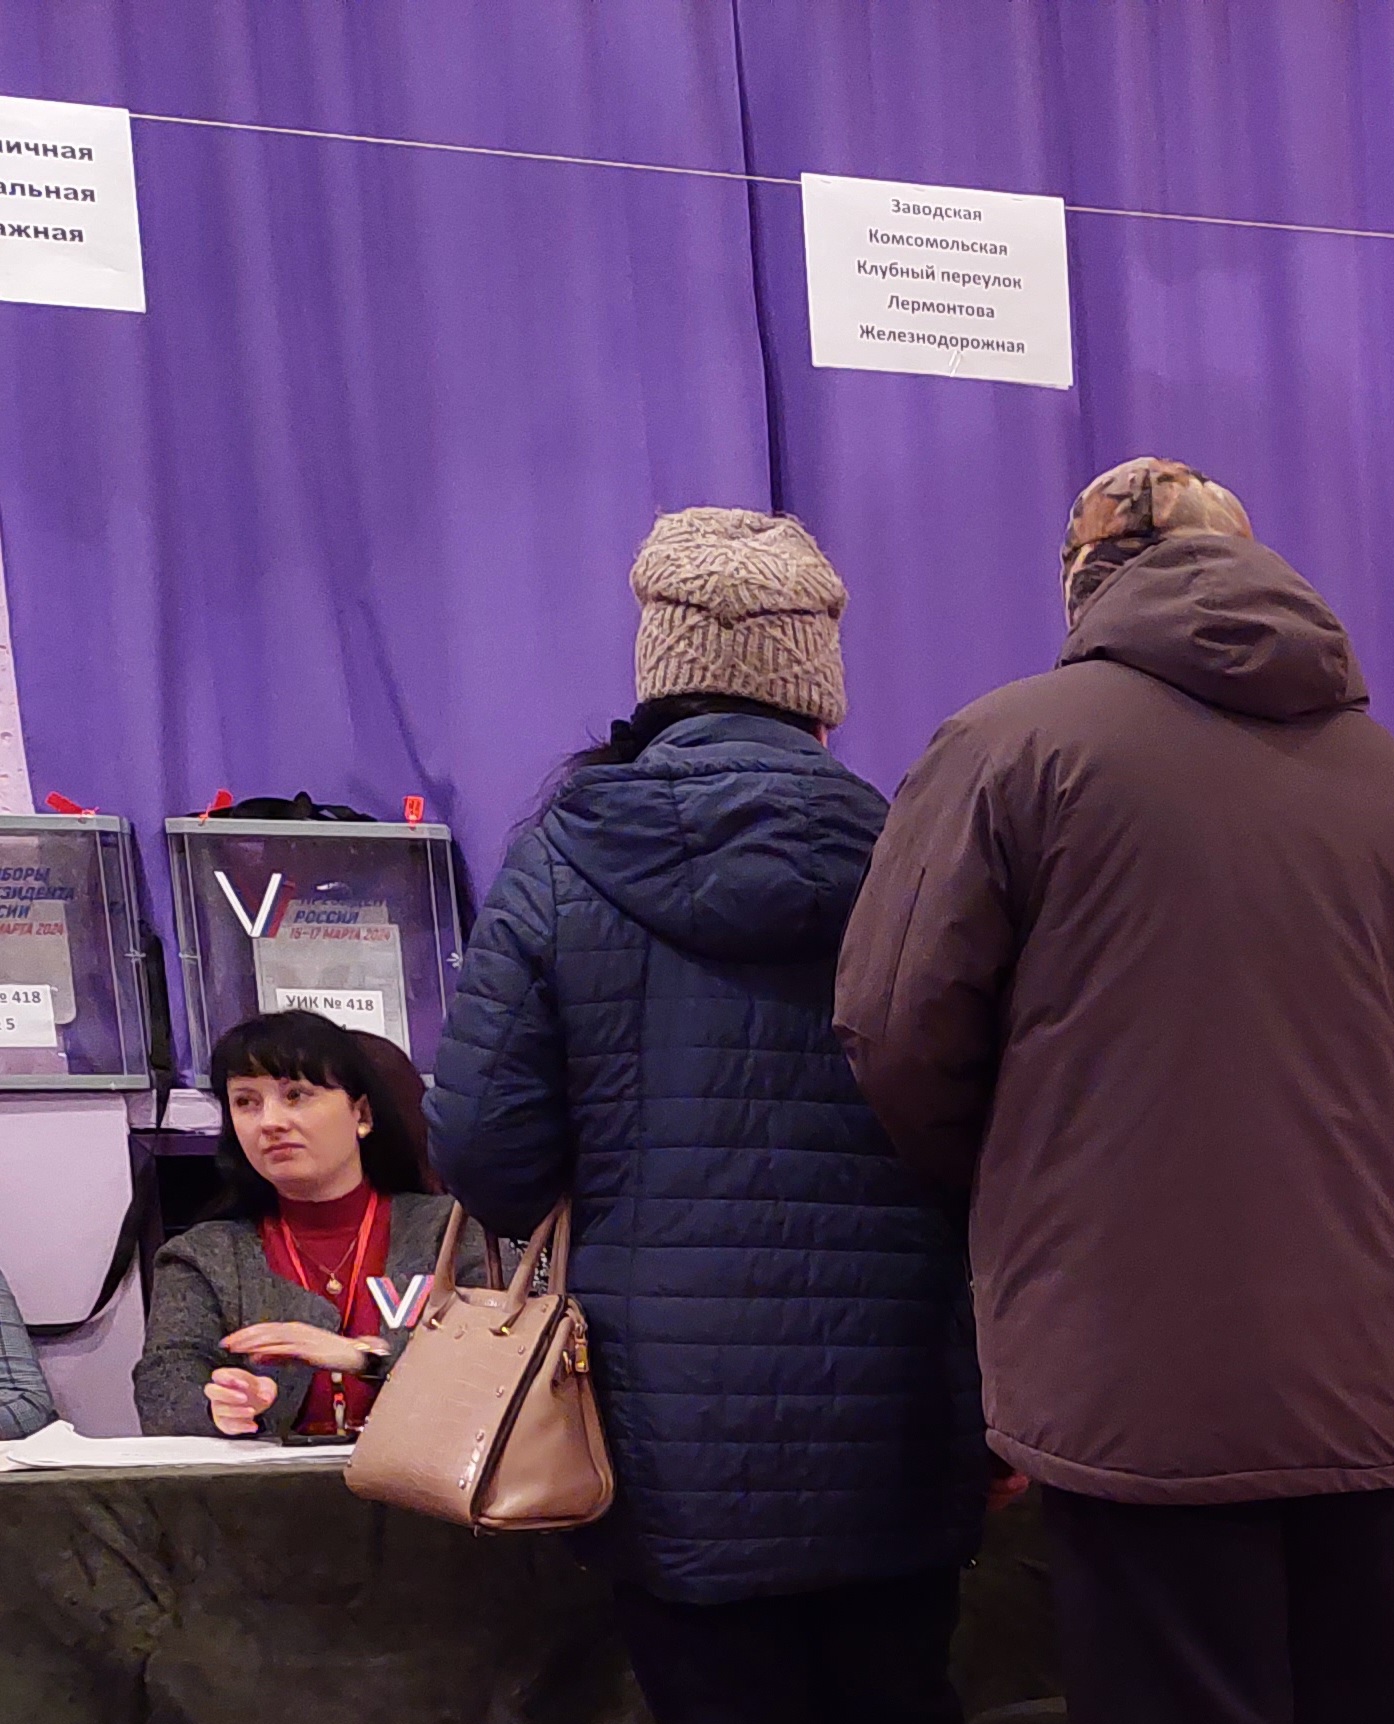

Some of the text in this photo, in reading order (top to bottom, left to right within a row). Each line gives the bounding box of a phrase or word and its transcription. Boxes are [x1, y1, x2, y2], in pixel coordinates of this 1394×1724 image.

[0, 139, 93, 162] ичная
[891, 199, 982, 221] Заводская
[869, 229, 1008, 256] Комсомольская
[857, 260, 1022, 290] Клубный переулок
[888, 295, 995, 318] Лермонтова
[859, 324, 1025, 353] Железнодорожная
[294, 910, 359, 924] РОССИИ
[12, 991, 41, 1003] 418
[286, 995, 374, 1011] УИК № 418
[5, 1018, 16, 1030] 5
